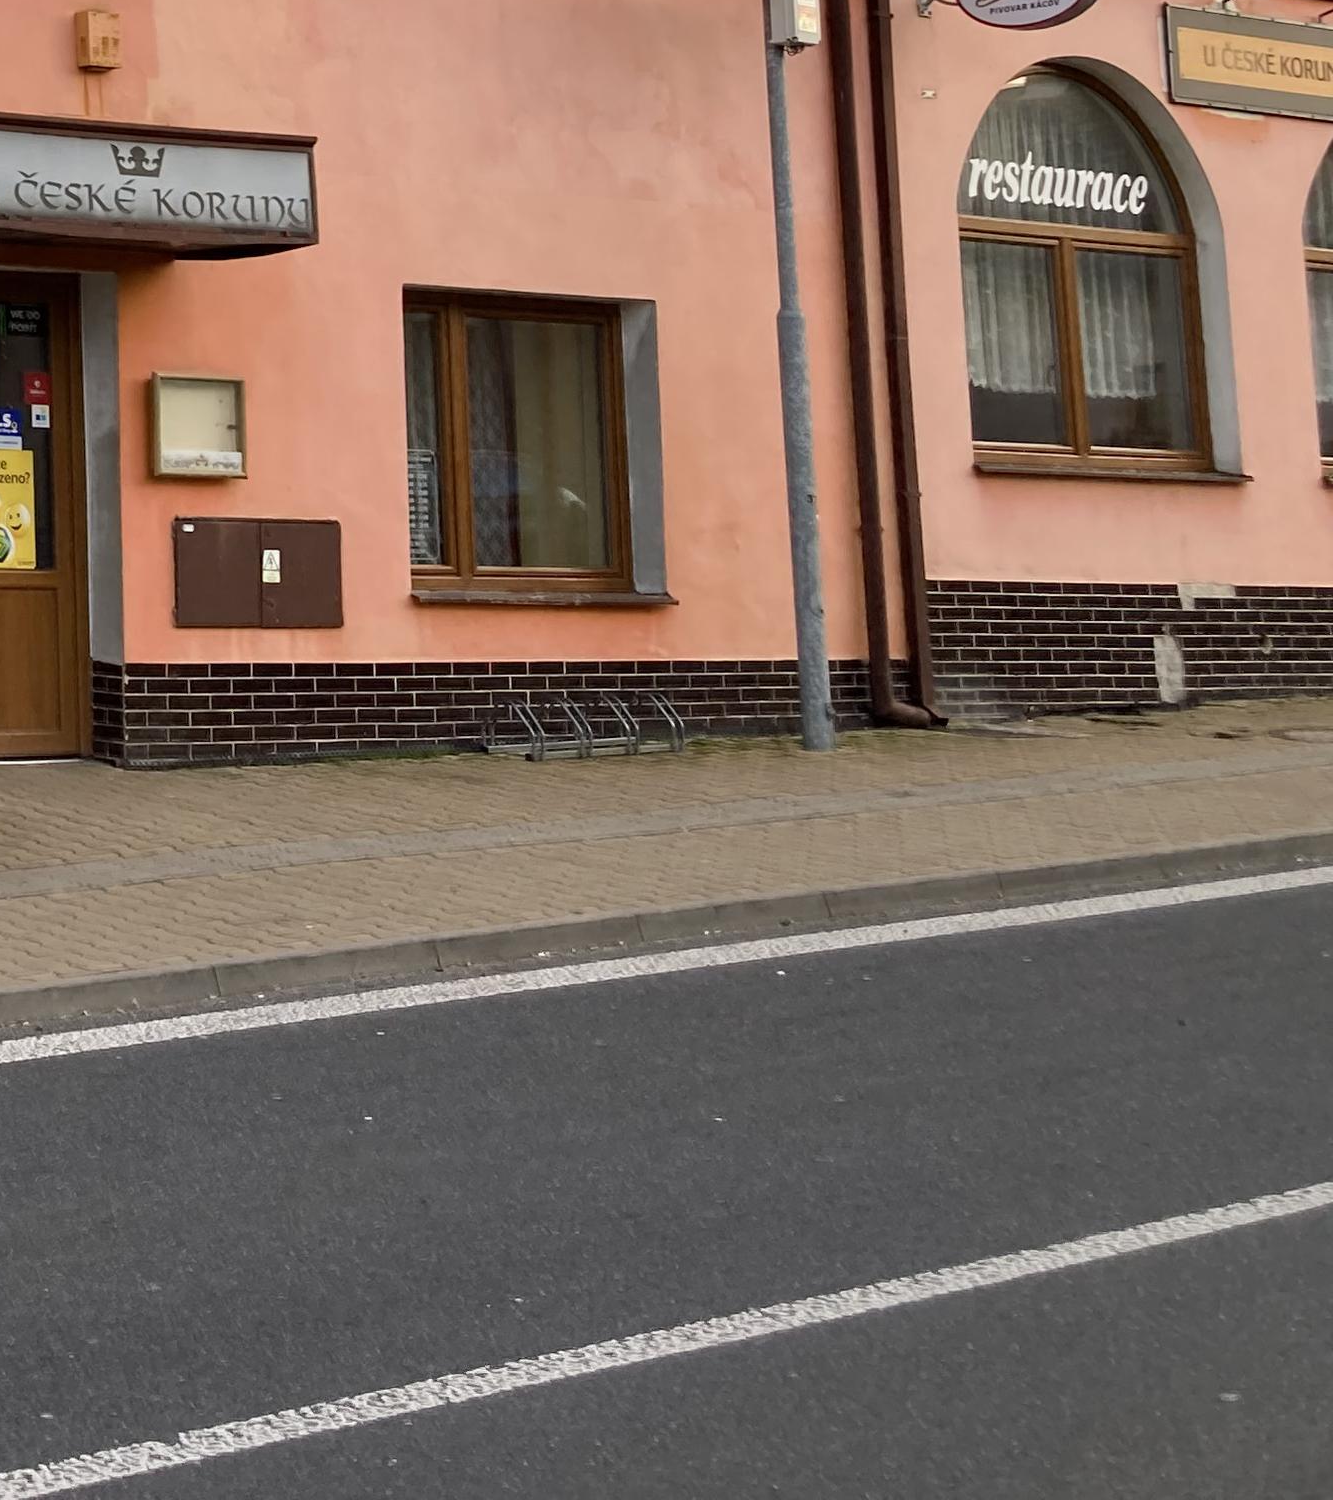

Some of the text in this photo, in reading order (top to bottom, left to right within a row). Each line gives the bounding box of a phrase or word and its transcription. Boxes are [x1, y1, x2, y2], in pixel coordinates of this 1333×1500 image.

[989, 0, 1060, 15] PIVOVAR KÁCOV
[1203, 45, 1215, 67] U
[1221, 42, 1277, 76] ČESKÉ
[14, 170, 136, 214] ČESKÉ
[968, 150, 1149, 215] restaurace
